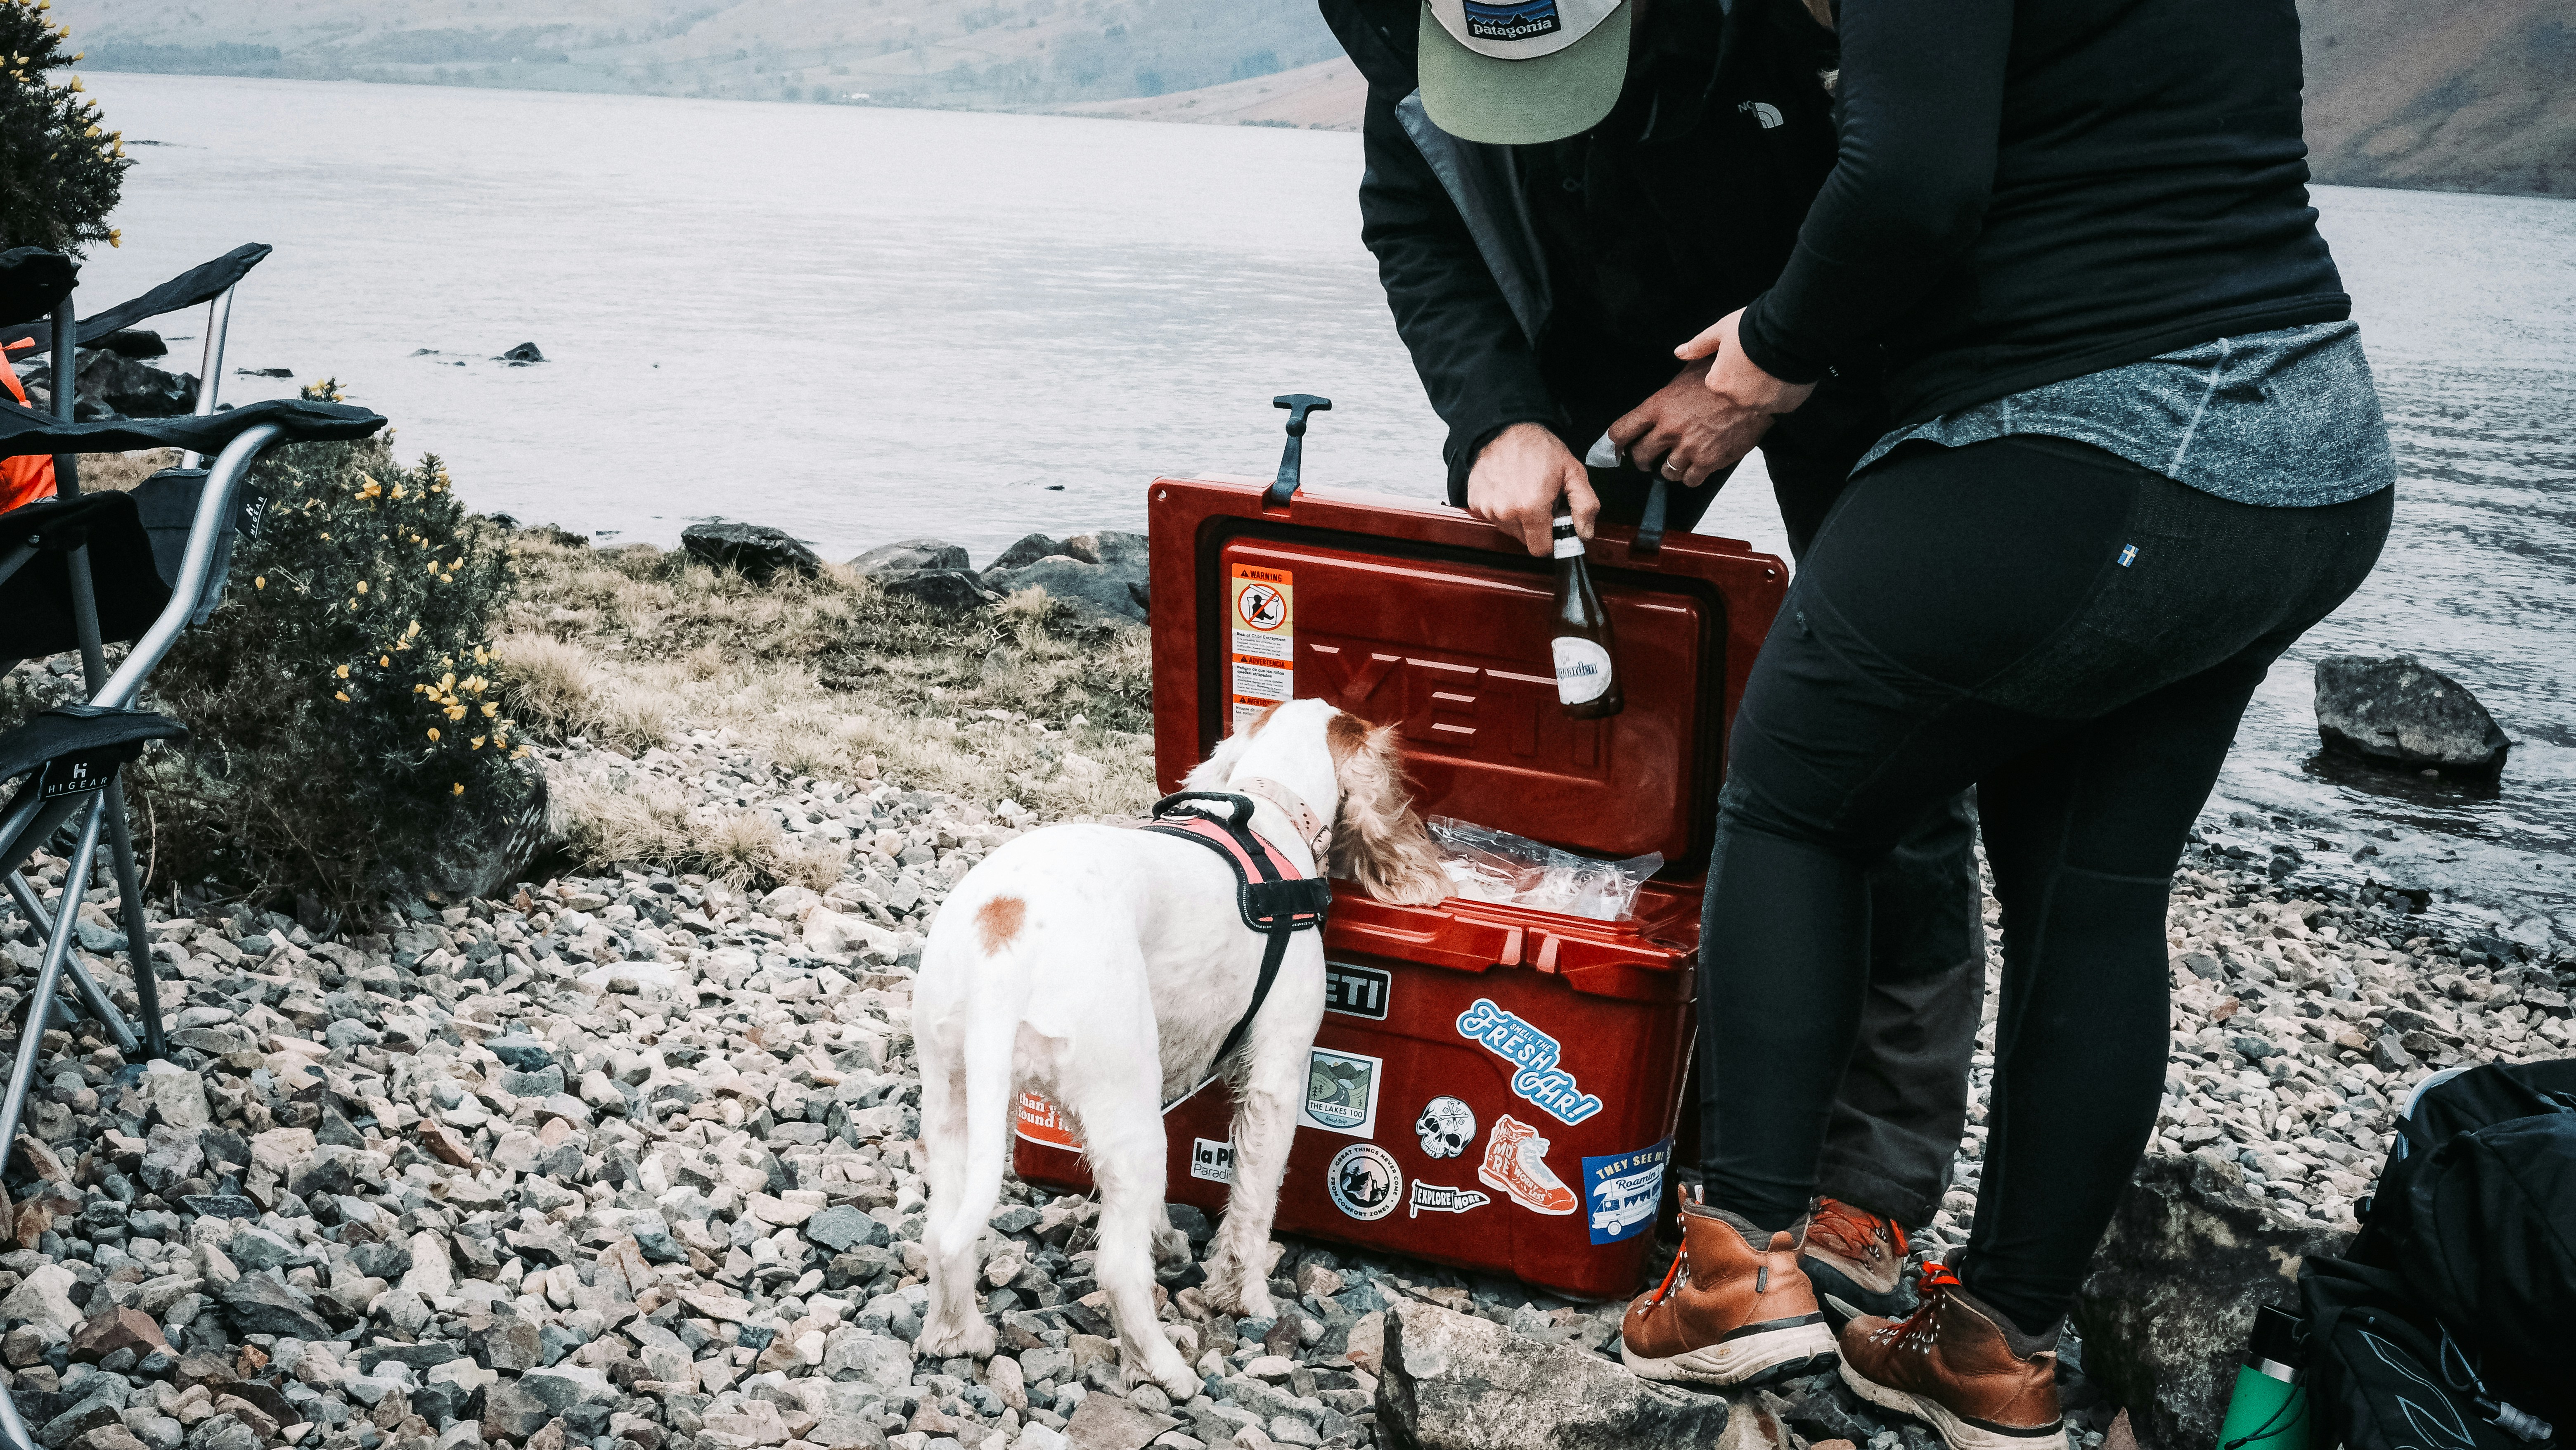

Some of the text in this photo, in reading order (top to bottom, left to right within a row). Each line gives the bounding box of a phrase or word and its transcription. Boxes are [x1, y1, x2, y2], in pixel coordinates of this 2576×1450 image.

[1473, 19, 1552, 38] patagonia
[1250, 570, 1282, 582] WARNING
[1249, 657, 1285, 668] ADVERTENCIA
[1326, 973, 1378, 1009] ETI
[1463, 1005, 1552, 1071] FRESH
[1510, 1023, 1553, 1052] SMELL THE
[1518, 1072, 1595, 1118] AIR!
[1310, 1102, 1323, 1110] THE
[1325, 1105, 1347, 1115] LAKES
[1196, 1142, 1213, 1164] la
[1335, 1149, 1352, 1166] GREAT
[1380, 1154, 1396, 1174] NEVER
[1596, 1159, 1627, 1180] THEY
[1633, 1153, 1652, 1166] SEE
[1514, 1165, 1539, 1191] WORRY
[1417, 1188, 1480, 1209] EXPLORE MORE
[1528, 1189, 1546, 1202] LESS
[1338, 1198, 1367, 1217] COMFORT
[1369, 1204, 1390, 1217] ZONES
